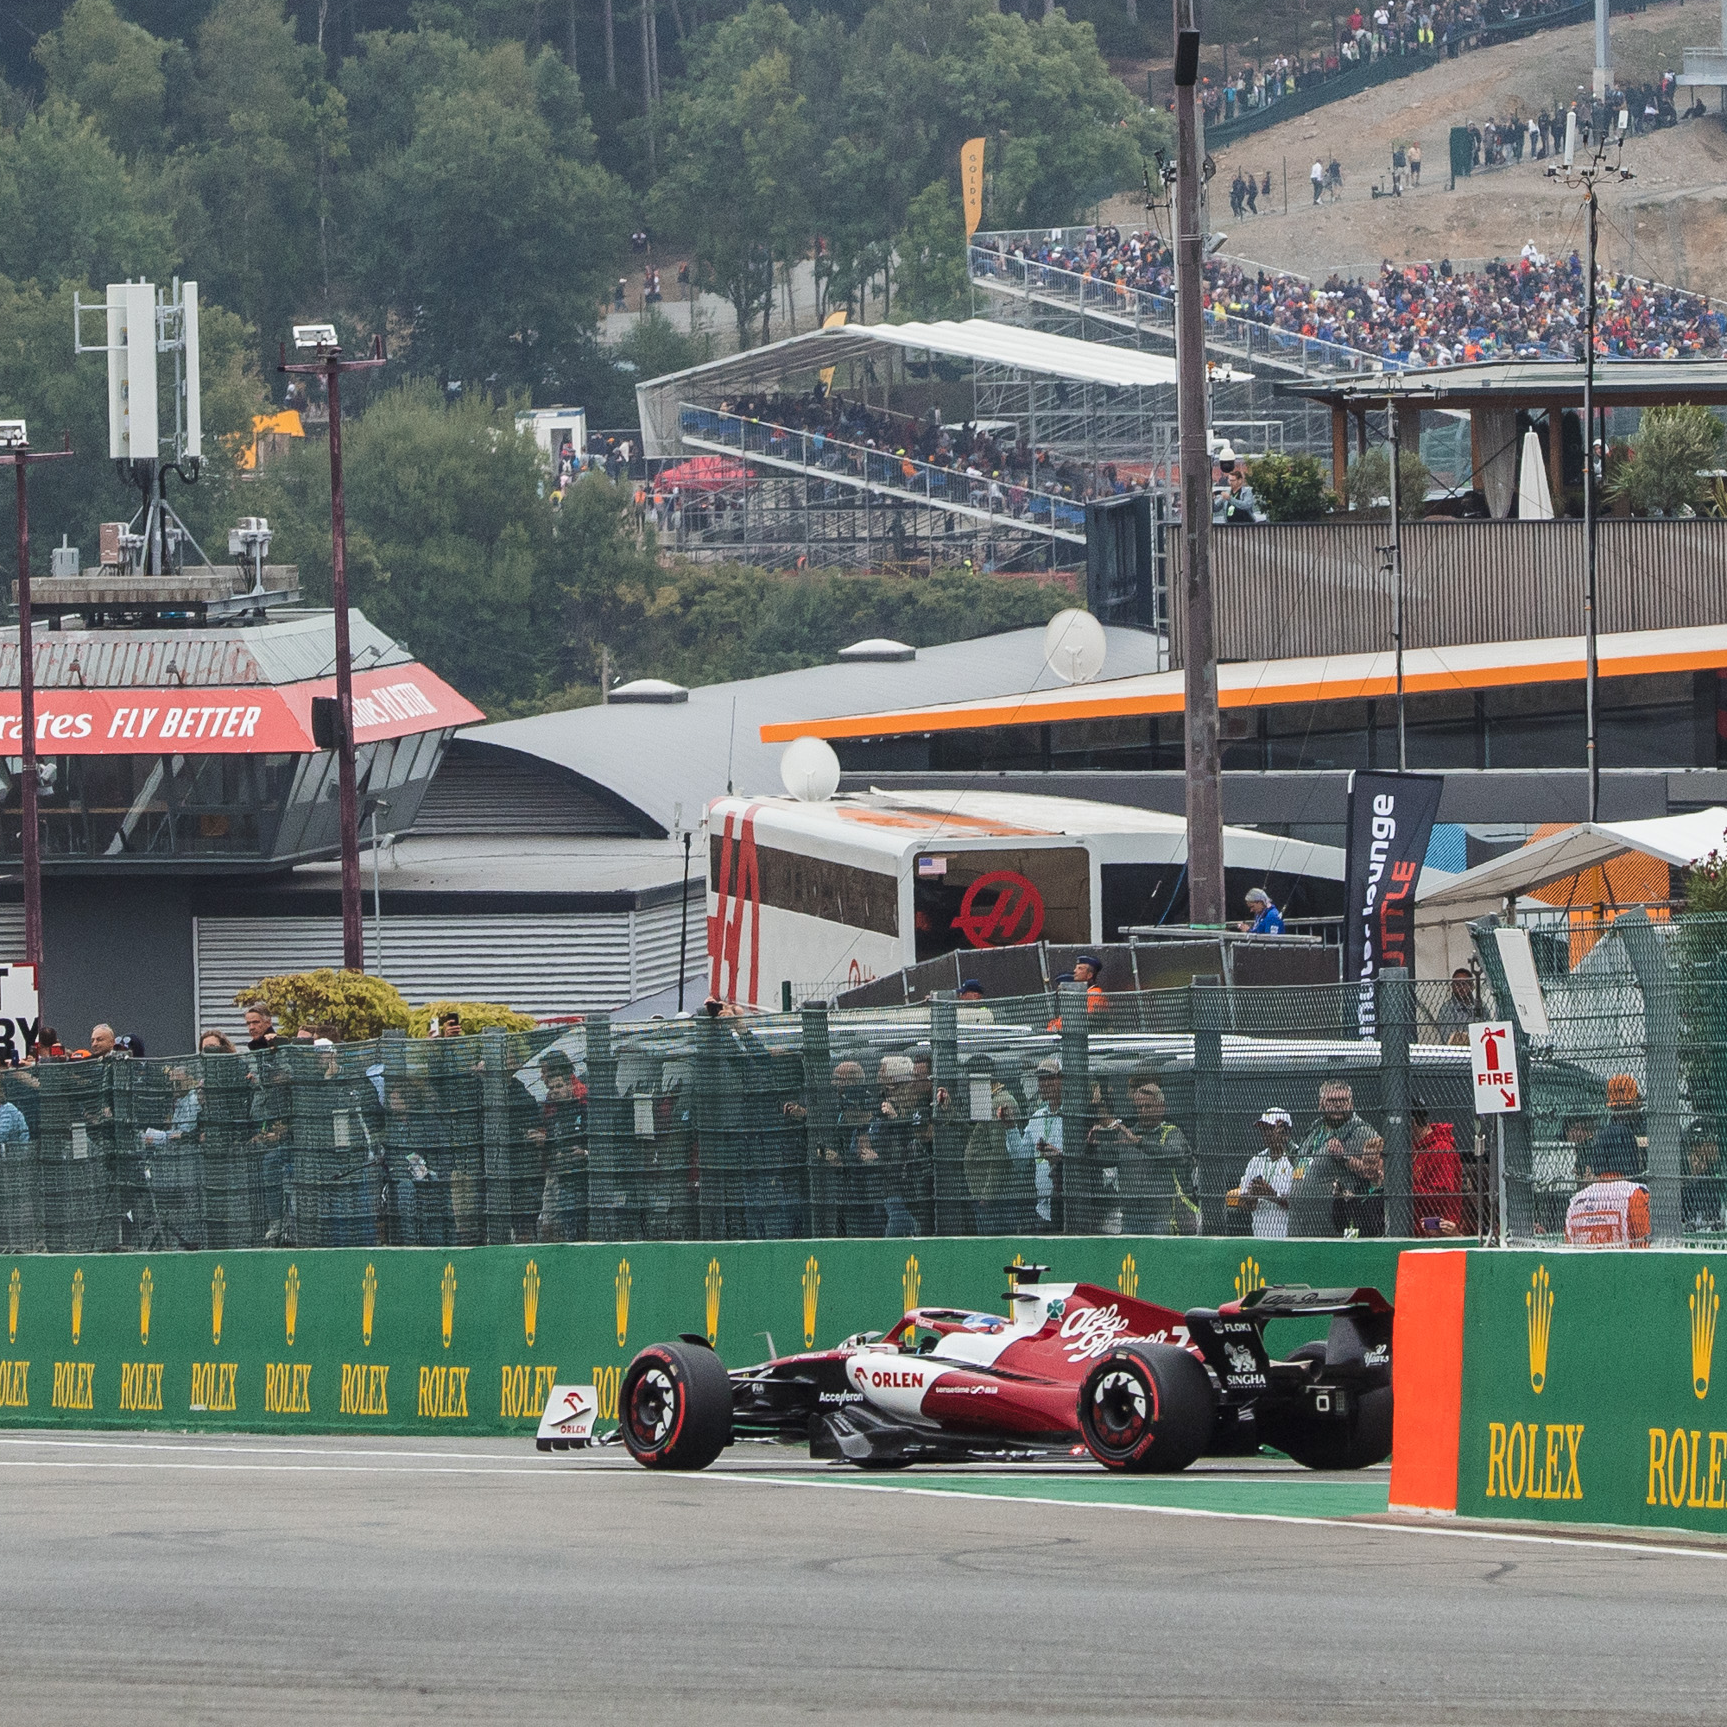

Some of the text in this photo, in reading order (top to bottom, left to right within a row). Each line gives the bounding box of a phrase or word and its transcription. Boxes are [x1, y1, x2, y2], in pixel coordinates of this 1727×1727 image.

[107, 708, 159, 739] FLY
[159, 706, 262, 738] BETTER
[1362, 793, 1397, 917] lounge
[1381, 859, 1416, 967] UTTLE
[1477, 1071, 1514, 1086] FIRE
[1059, 1304, 1129, 1338] Alfa
[1225, 1323, 1251, 1332] FLOKI
[872, 1372, 924, 1388] ORLEN
[1227, 1374, 1266, 1385] SINGHA
[1364, 1352, 1389, 1367] Years
[52, 1361, 96, 1410] ROLEX
[120, 1363, 164, 1411] ROLEX
[191, 1363, 238, 1411] ROLEX
[265, 1363, 312, 1413] ROLEX
[340, 1364, 390, 1415] ROLEX
[418, 1366, 470, 1418] ROLEX
[561, 1425, 586, 1434] ORLEN
[1485, 1421, 1584, 1500] ROLEX
